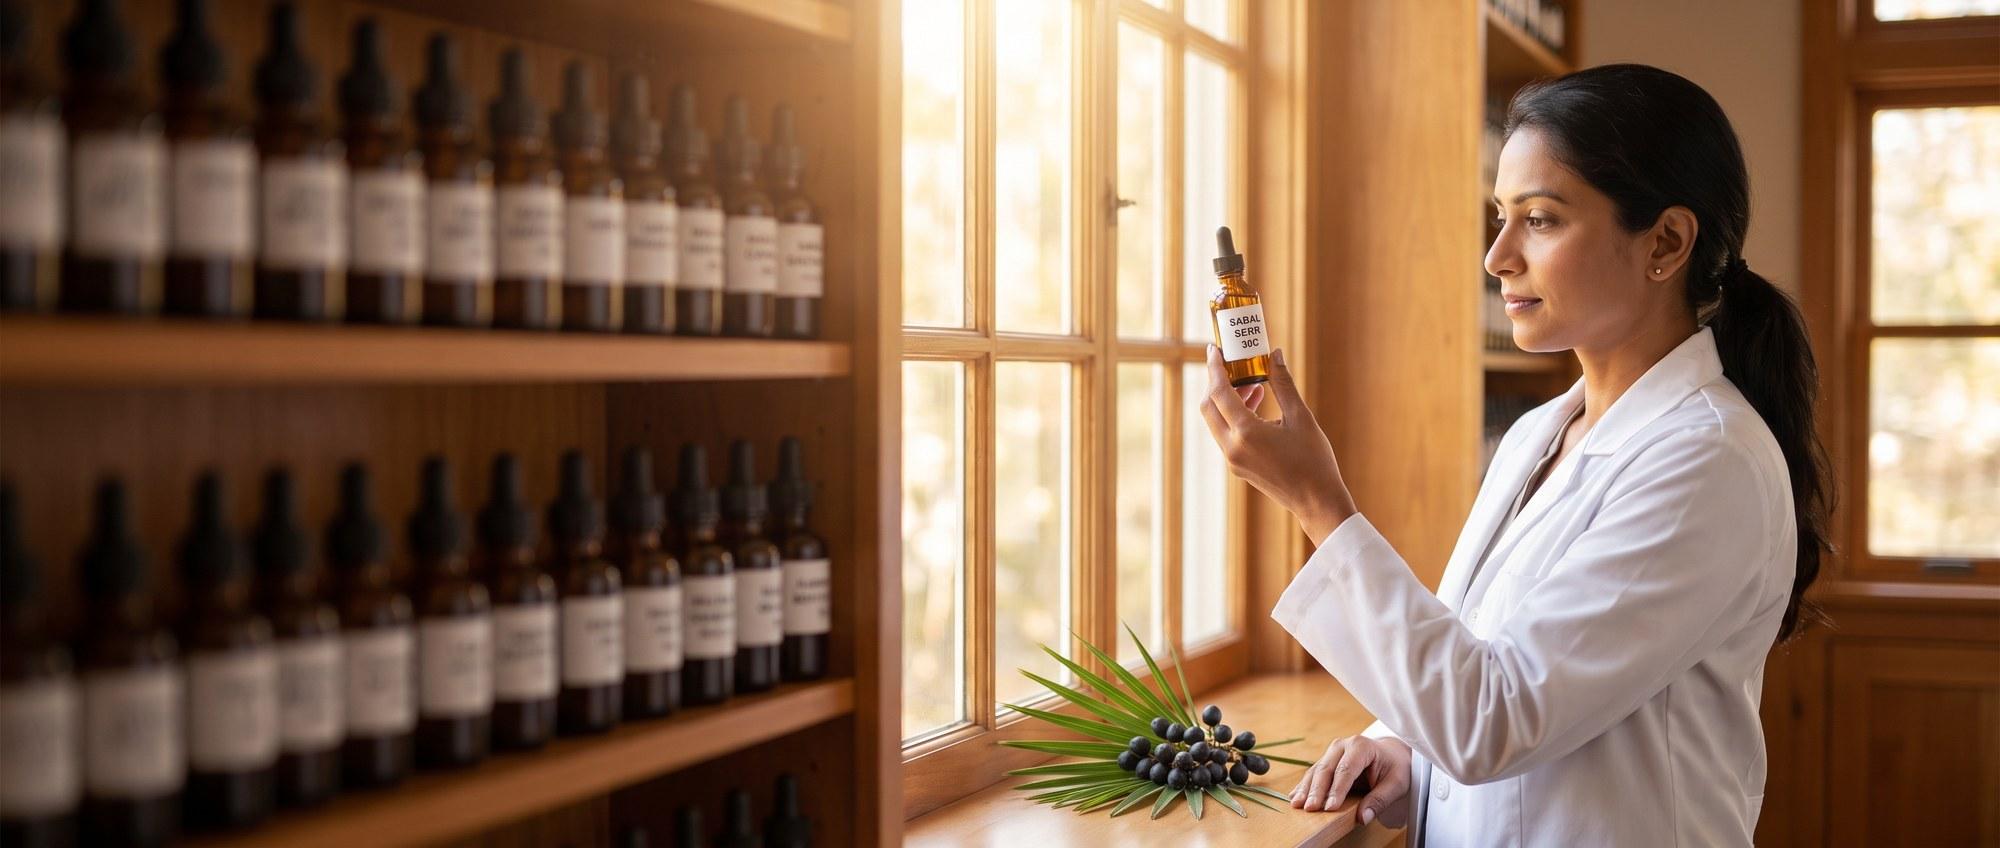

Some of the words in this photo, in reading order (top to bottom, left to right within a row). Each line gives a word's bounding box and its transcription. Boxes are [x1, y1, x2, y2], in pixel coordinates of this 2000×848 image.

[1229, 314, 1261, 326] SABAL
[1234, 326, 1261, 337] SERR
[1241, 338, 1259, 349] 30C
